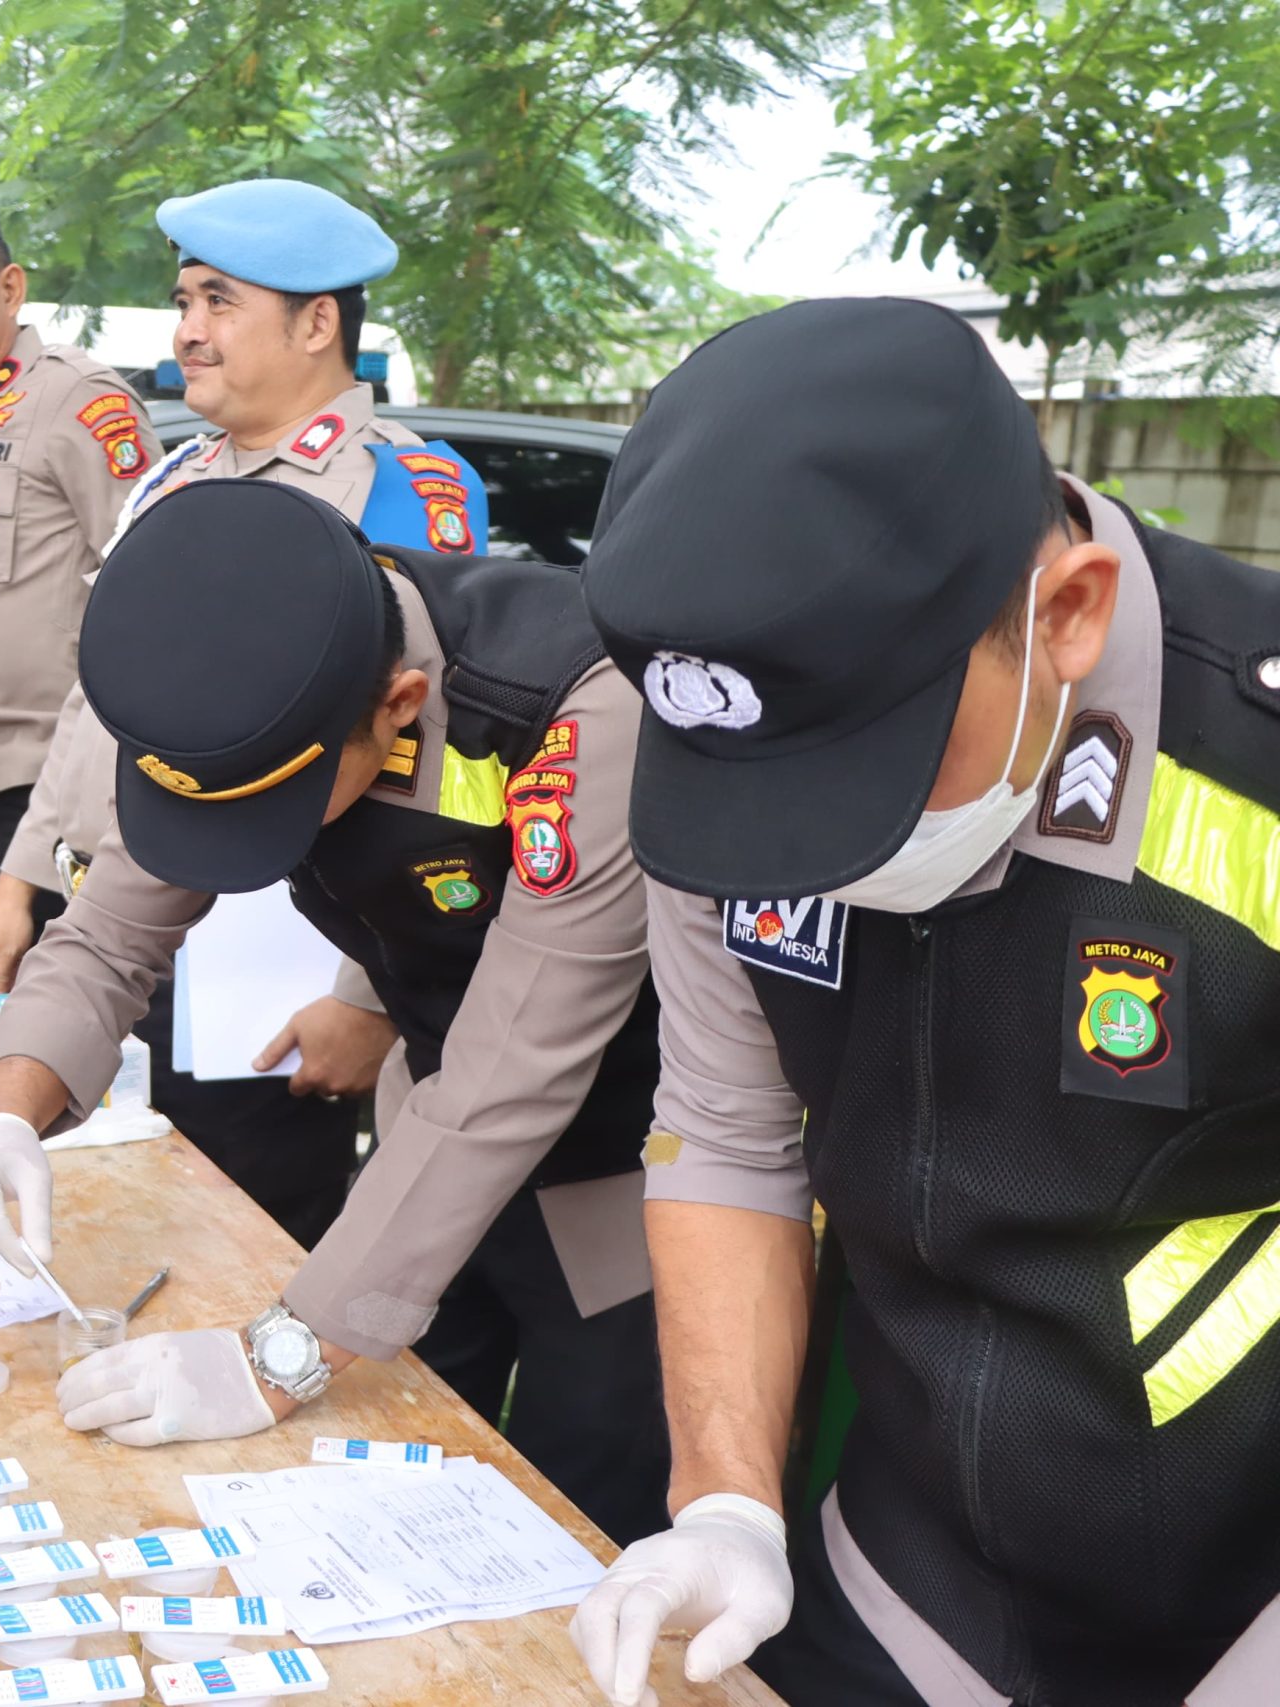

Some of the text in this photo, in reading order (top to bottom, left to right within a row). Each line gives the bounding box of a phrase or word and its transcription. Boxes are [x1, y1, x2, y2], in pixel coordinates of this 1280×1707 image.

[539, 772, 569, 788] JAYA
[413, 858, 466, 873] METRO JAYA
[1085, 944, 1166, 969] METRO JAYA
